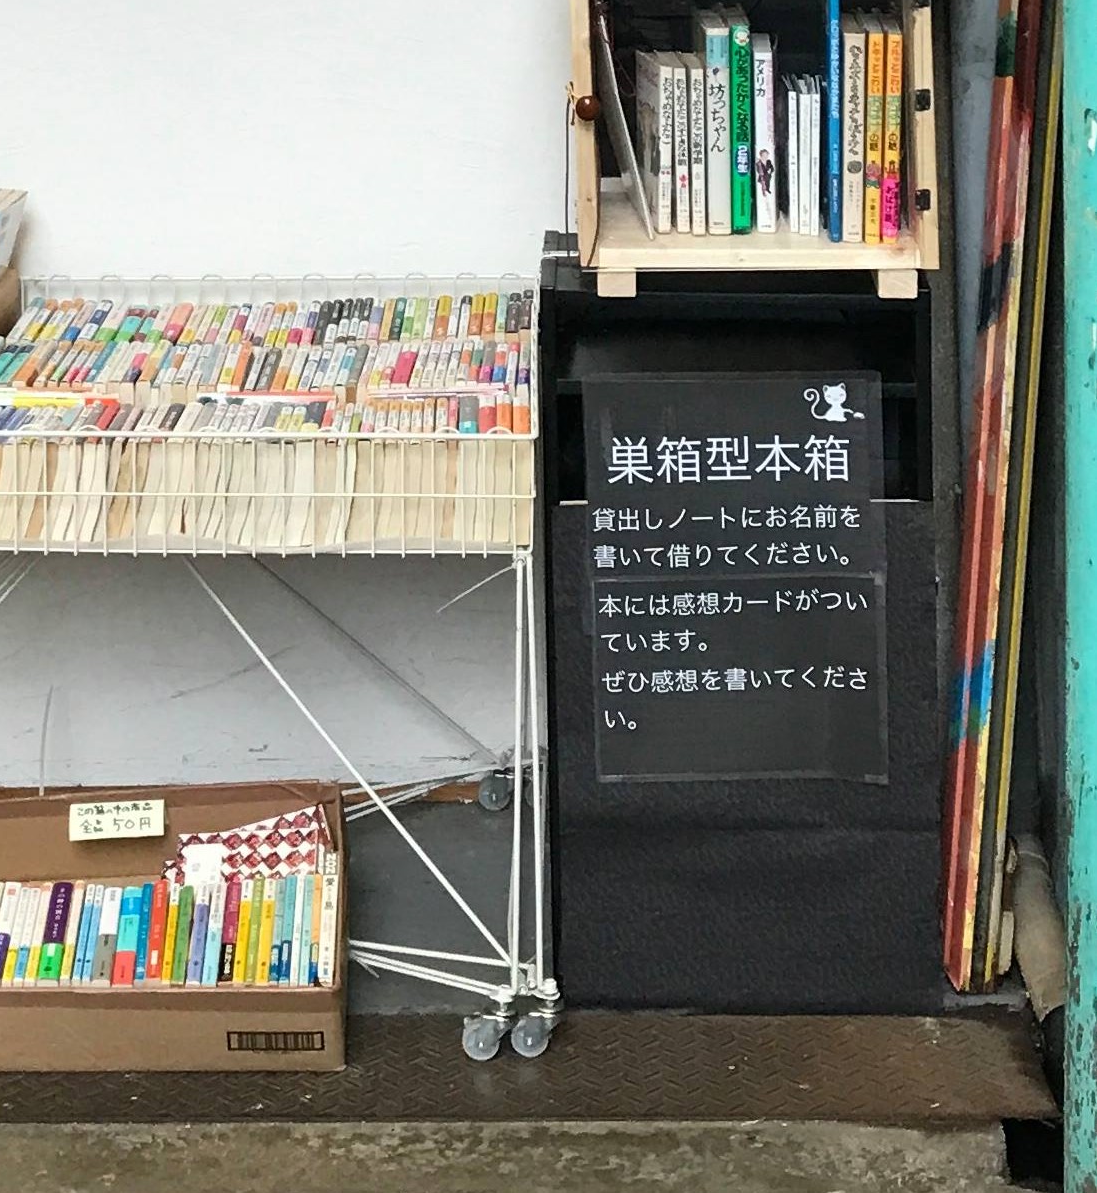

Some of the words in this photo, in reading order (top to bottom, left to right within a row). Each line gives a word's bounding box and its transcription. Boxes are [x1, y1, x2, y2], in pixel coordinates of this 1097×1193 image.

[756, 59, 766, 98] アメリカ
[708, 83, 726, 153] 坊っちゃん
[607, 434, 851, 485] 巣箱型本箱
[592, 504, 862, 533] 貸出しノートにお名前を
[593, 541, 851, 569] 書いて借りてください。
[598, 589, 869, 618] 本には感想カードがつい
[600, 629, 709, 653] ています。
[601, 666, 869, 694] ぜひ感想を書いてくださ
[604, 710, 638, 731] い。
